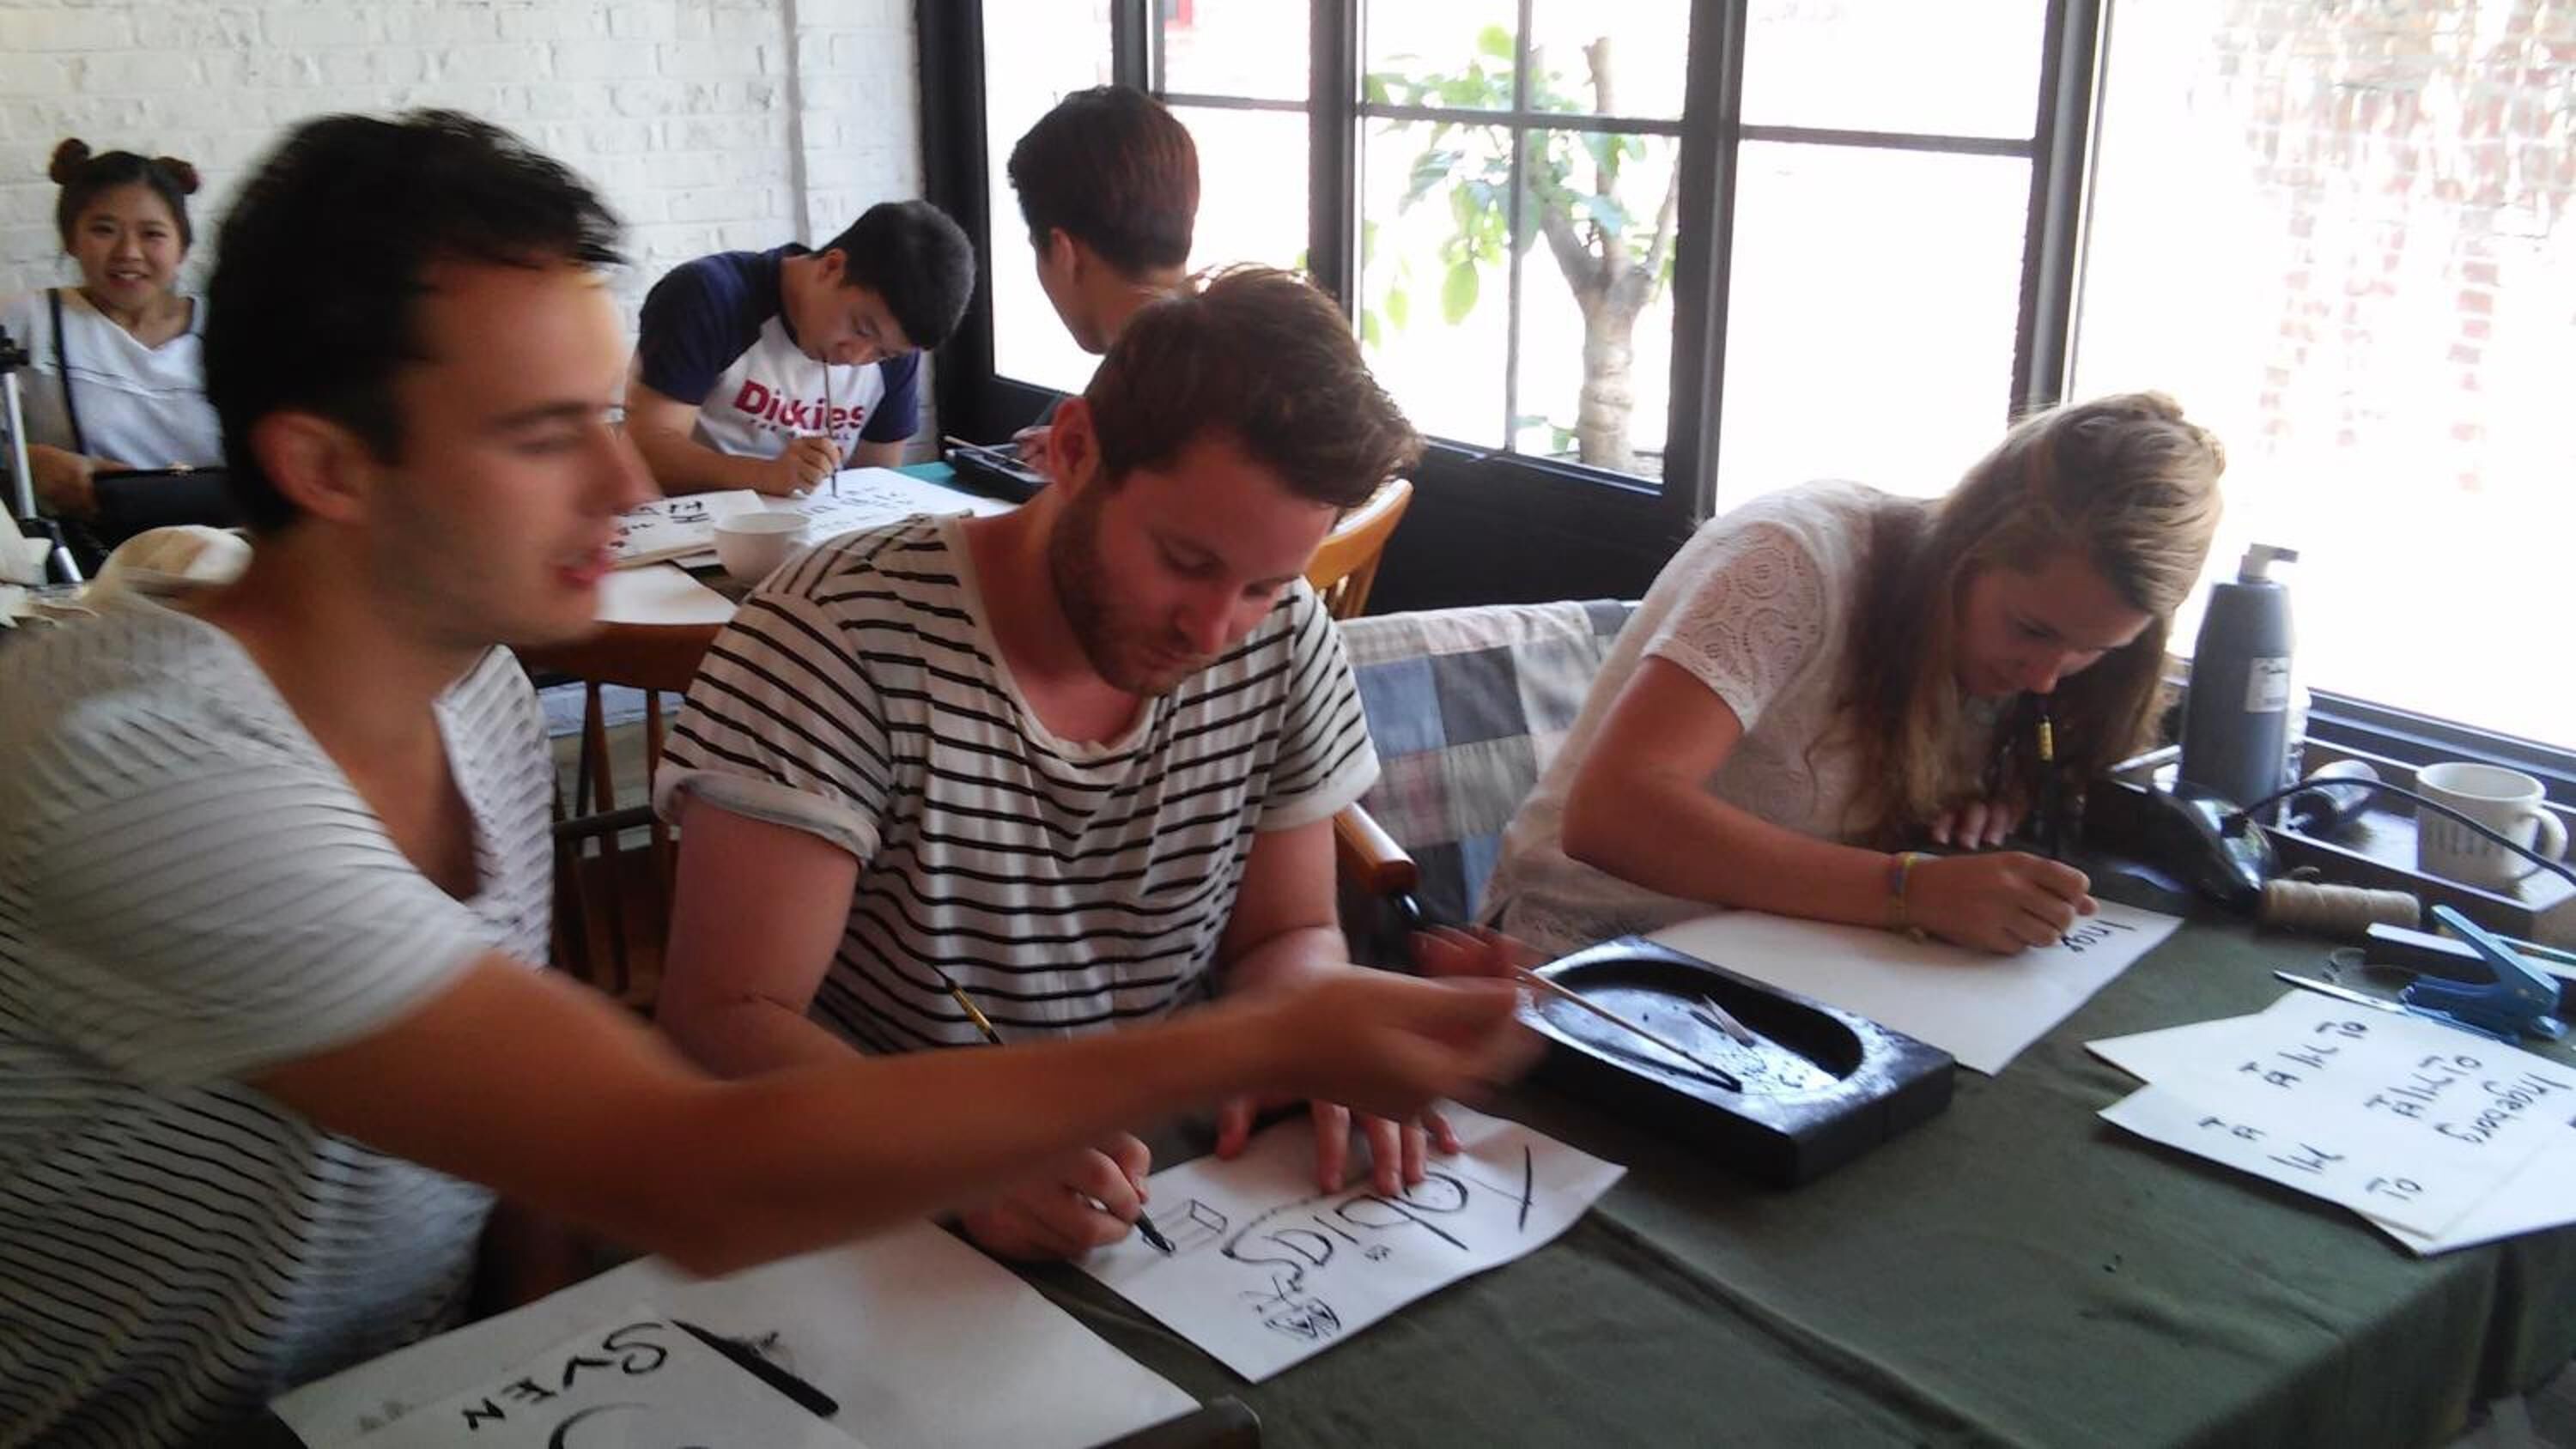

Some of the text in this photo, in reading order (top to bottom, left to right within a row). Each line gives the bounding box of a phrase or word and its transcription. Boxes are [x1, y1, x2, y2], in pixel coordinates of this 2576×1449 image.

[734, 380, 865, 430] Dickies
[2433, 1071, 2573, 1144] Ingeborg
[461, 1322, 668, 1431] SVEN
